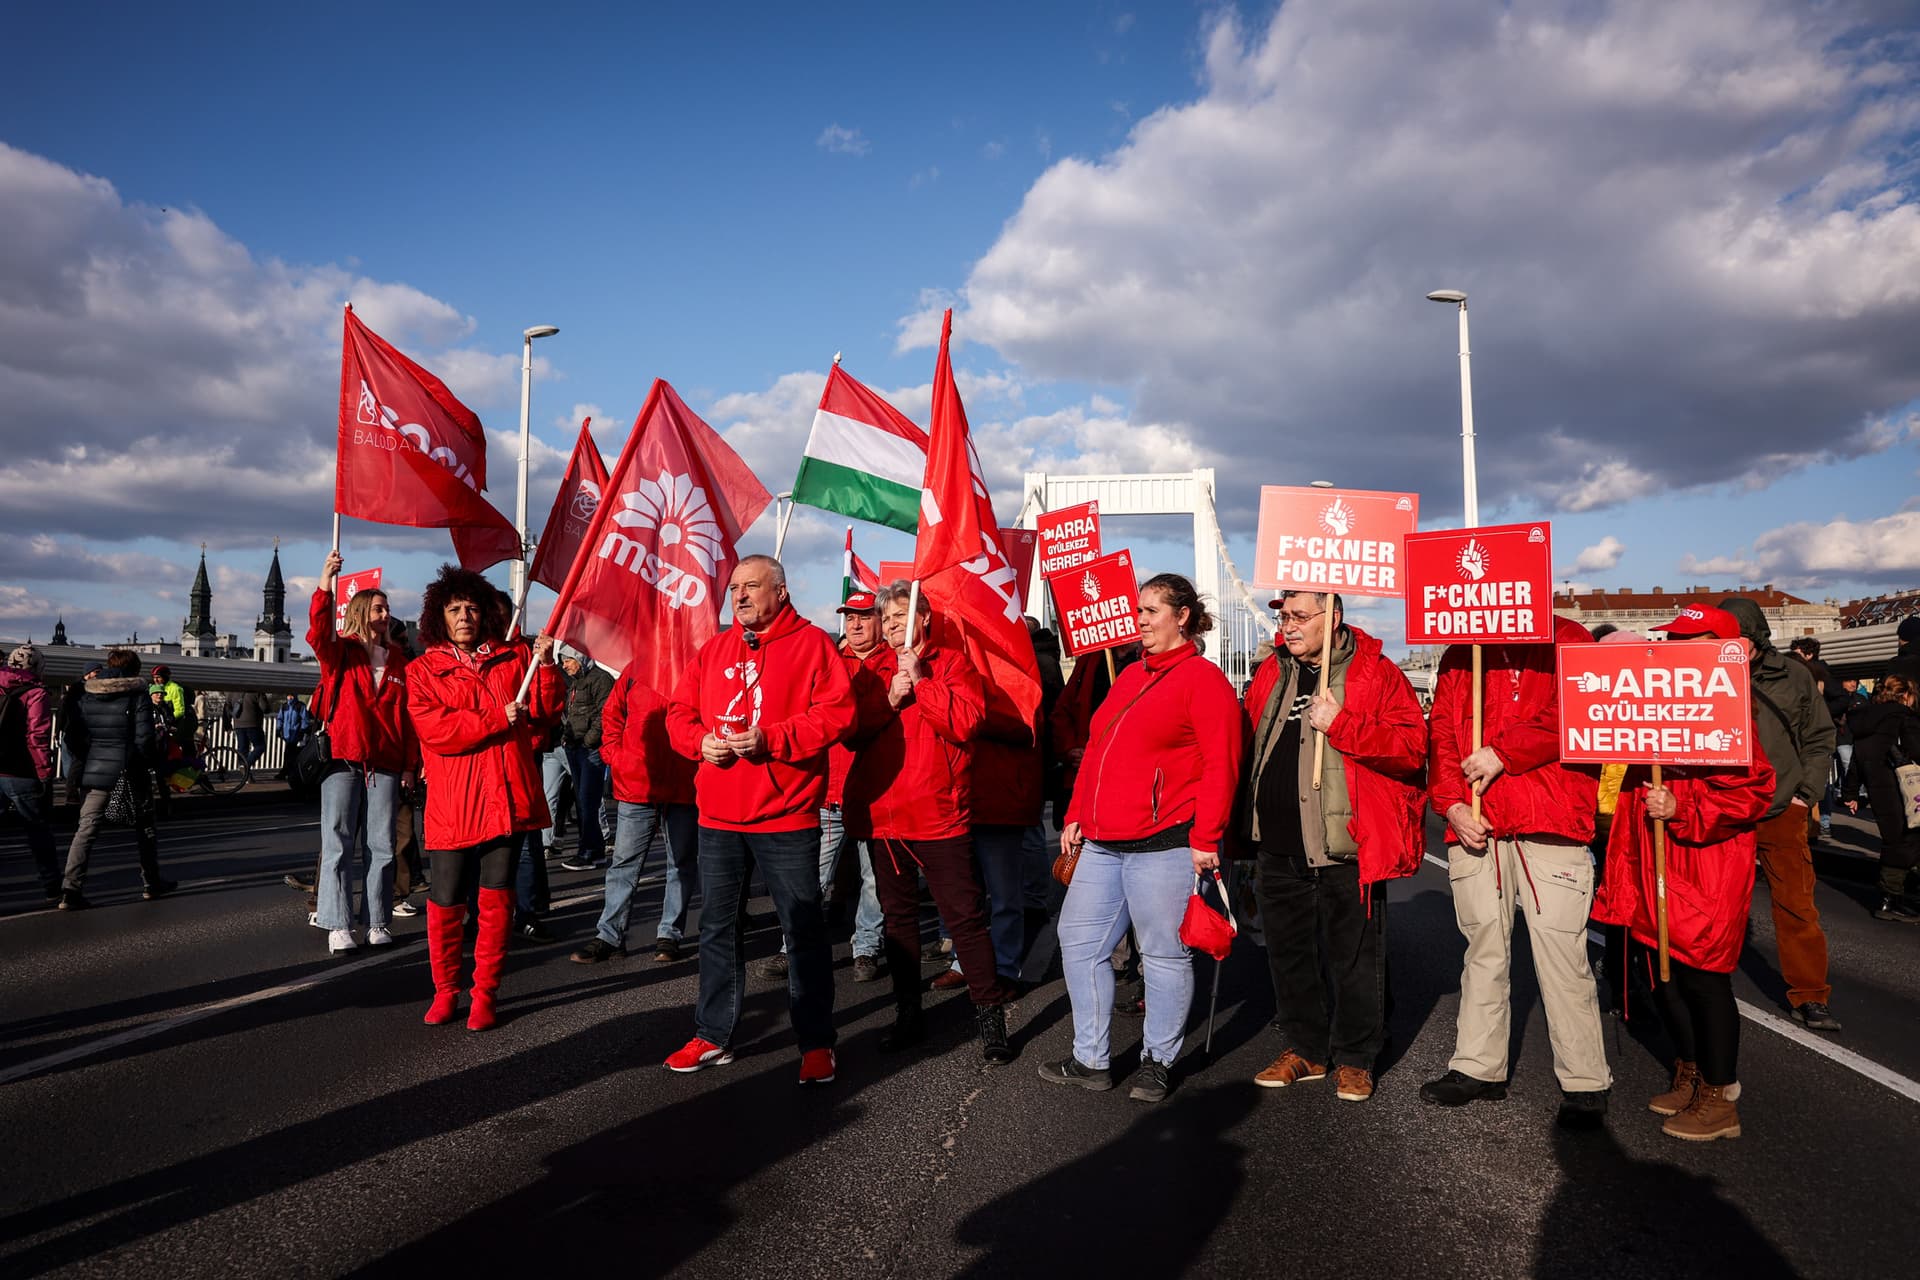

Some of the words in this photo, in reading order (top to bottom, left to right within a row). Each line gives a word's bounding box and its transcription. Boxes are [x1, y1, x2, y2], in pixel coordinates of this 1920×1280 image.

[1054, 516, 1096, 541] ARRA
[1047, 537, 1089, 555] GYÜLEKEZZ
[598, 532, 706, 609] mszp
[1041, 553, 1083, 573] NERRE!
[1276, 560, 1396, 588] FOREVER
[1071, 615, 1136, 649] FOREVER
[1424, 609, 1534, 634] FOREVER
[1611, 667, 1738, 698] ARRA
[1588, 700, 1714, 721] GYÜLEKEZZ
[1568, 728, 1691, 752] NERRE!
